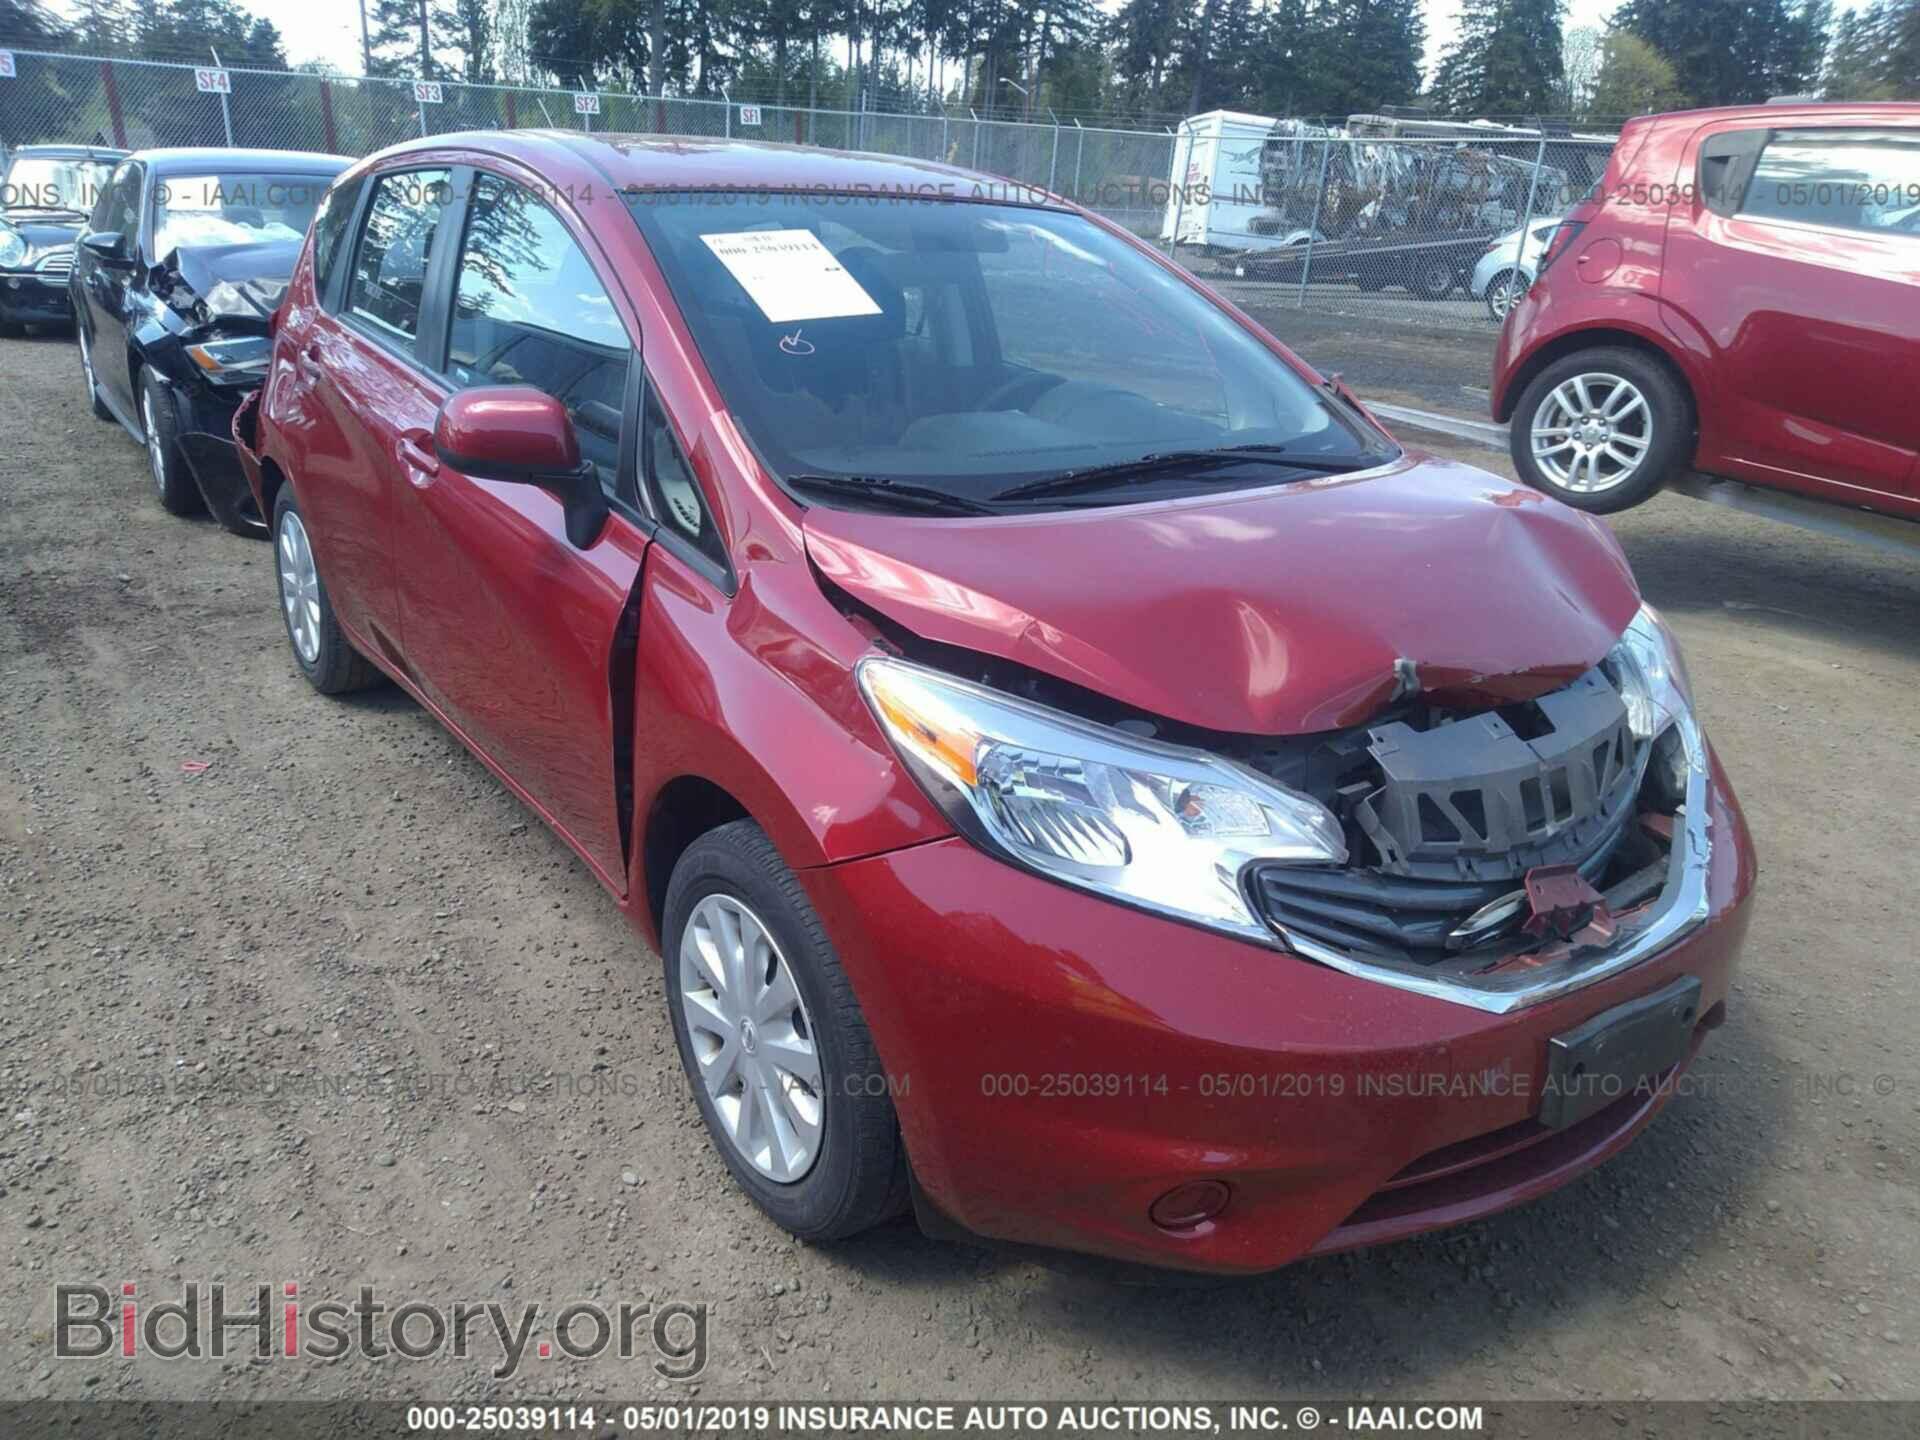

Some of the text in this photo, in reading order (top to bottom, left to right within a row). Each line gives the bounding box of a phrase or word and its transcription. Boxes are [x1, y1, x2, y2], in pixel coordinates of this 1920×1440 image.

[198, 71, 228, 91] SF4
[415, 83, 440, 101] SF3
[576, 95, 598, 112] SF2
[742, 108, 758, 123] SF1
